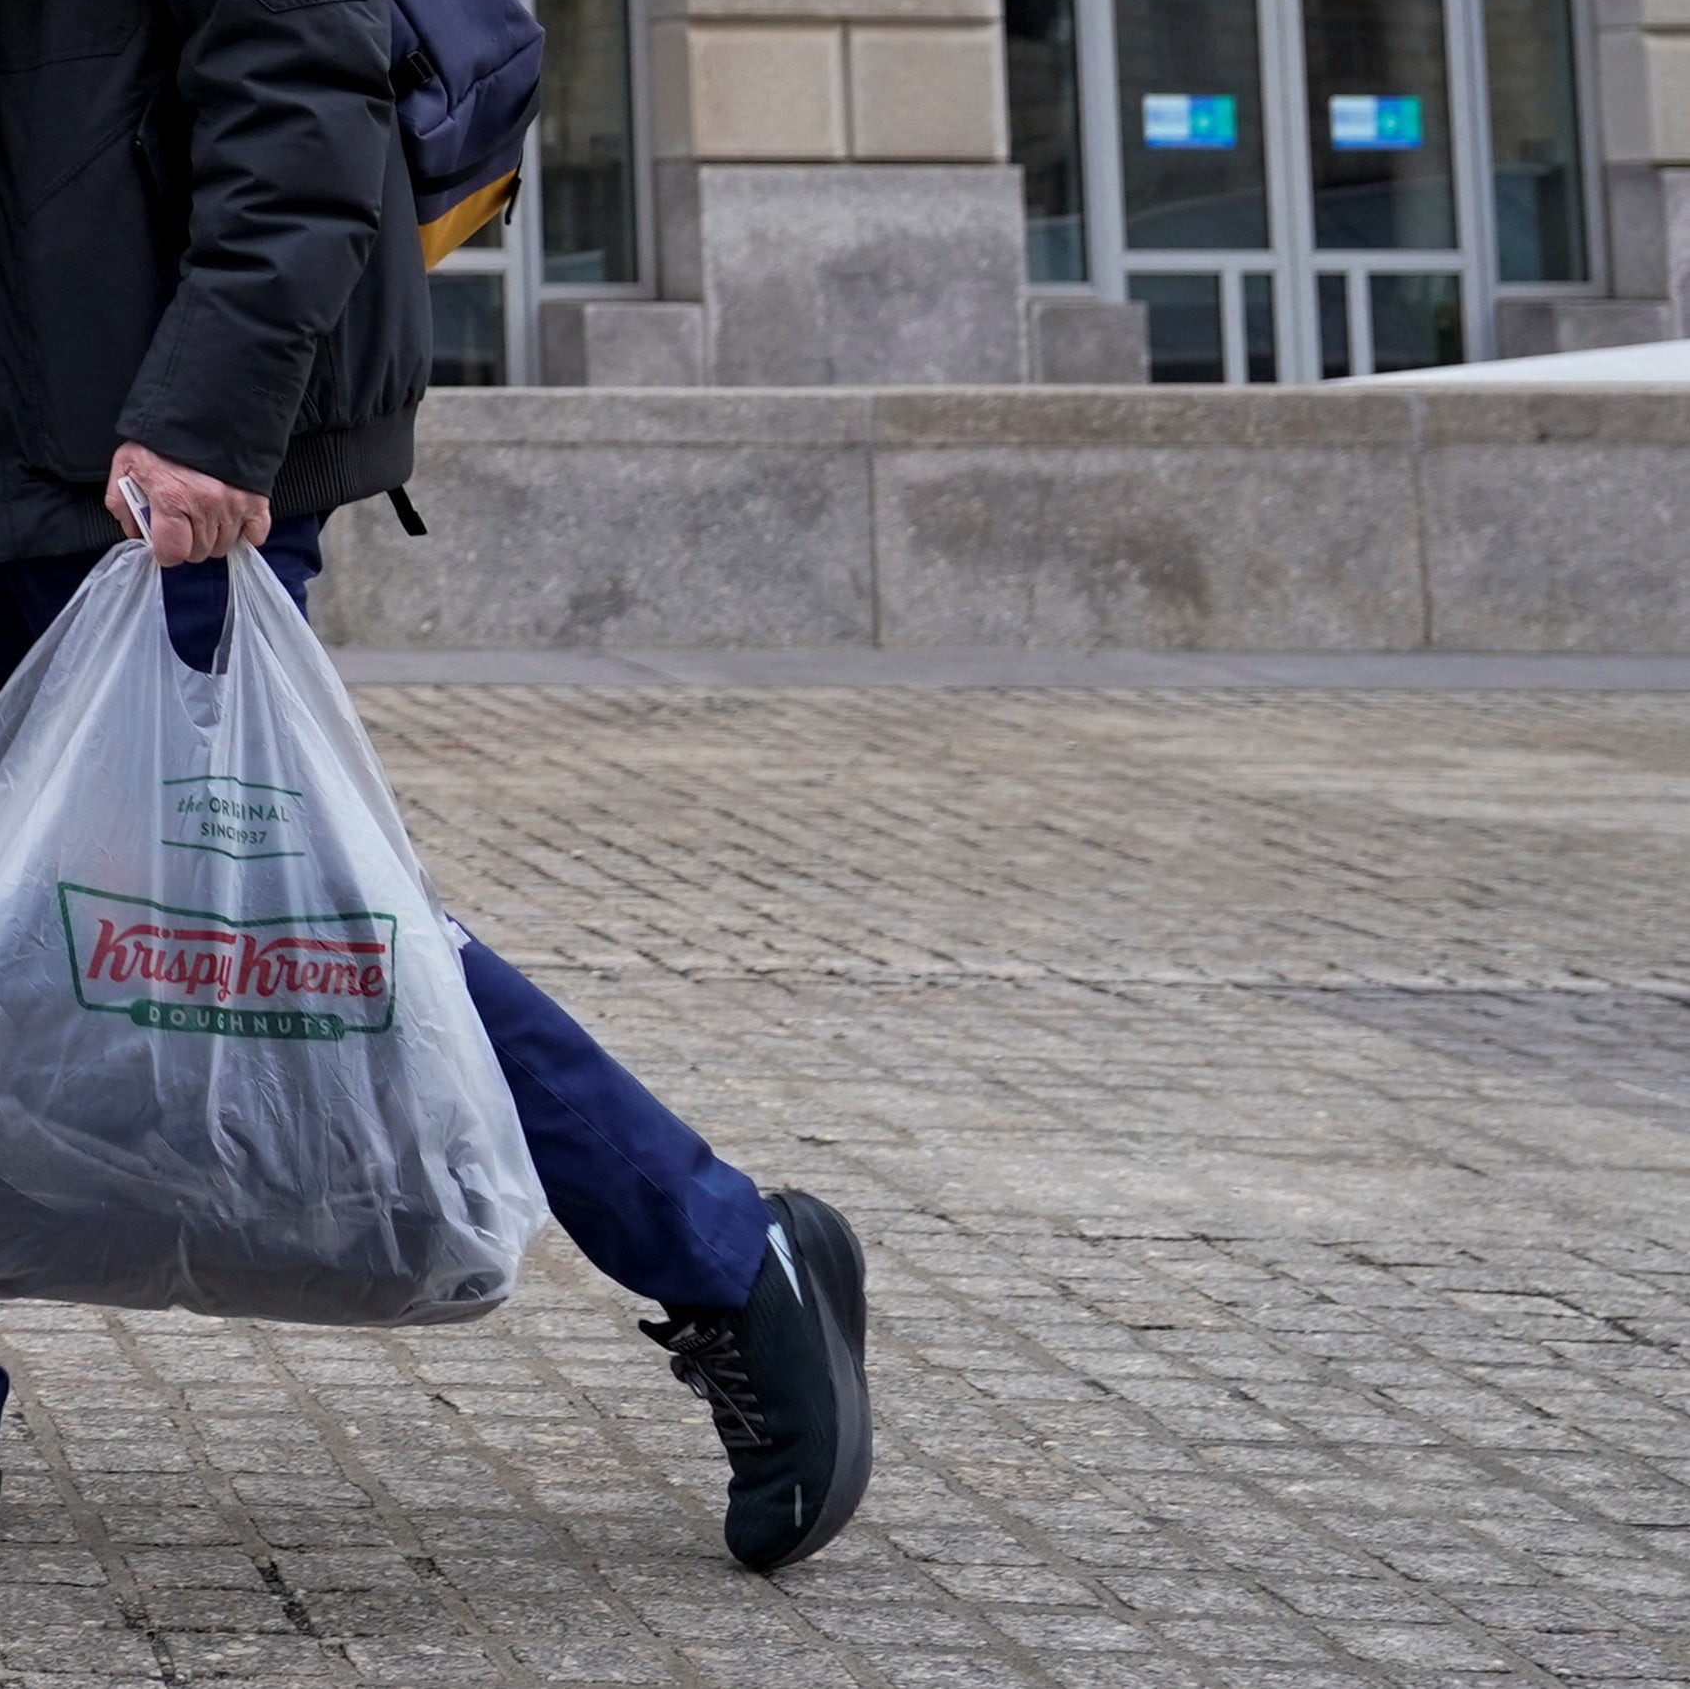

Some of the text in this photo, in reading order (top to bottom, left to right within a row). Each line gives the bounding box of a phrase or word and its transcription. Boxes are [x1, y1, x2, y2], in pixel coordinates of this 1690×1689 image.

[178, 795, 203, 813] the
[86, 918, 386, 1002] Krispy Kreme
[147, 1005, 332, 1038] DOUGHNUTS
